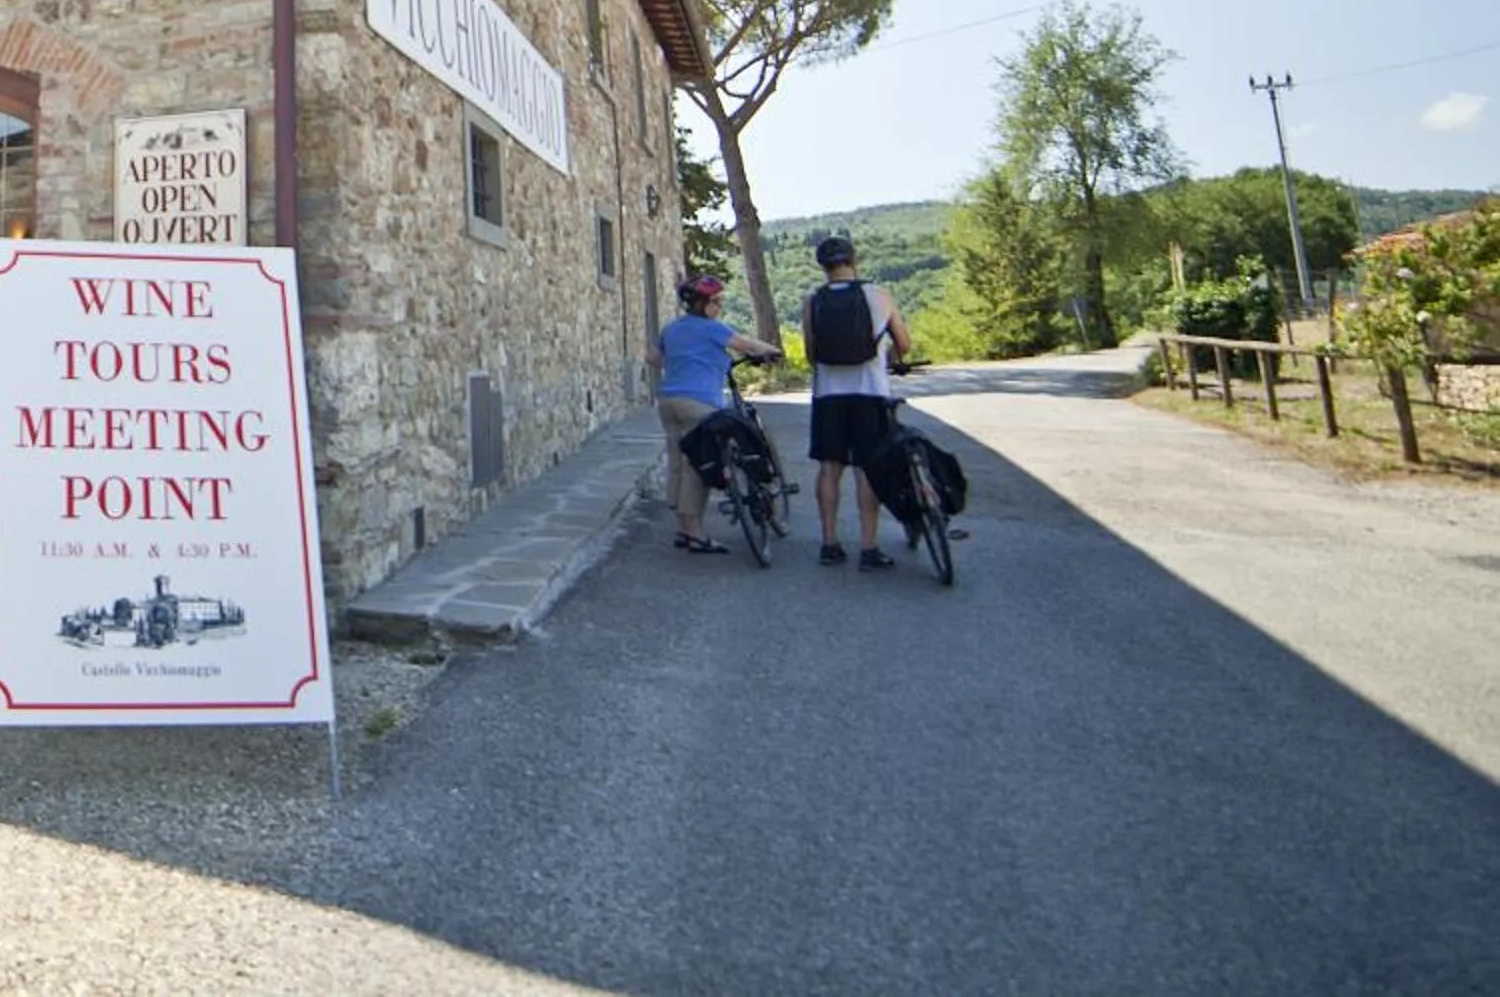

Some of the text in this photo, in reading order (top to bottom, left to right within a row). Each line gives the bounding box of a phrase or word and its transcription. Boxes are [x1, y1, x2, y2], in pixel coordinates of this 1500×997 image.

[124, 149, 237, 183] APERTO
[141, 183, 217, 214] OPEN
[123, 214, 238, 243] OUVERT
[69, 277, 214, 318] WINE
[54, 340, 232, 384] TOURS
[15, 406, 271, 452] MEETING
[60, 475, 233, 521] POINT
[40, 540, 83, 557] 11:30
[93, 542, 133, 558] A.M.
[147, 542, 161, 558] &
[218, 542, 258, 558] P.M.
